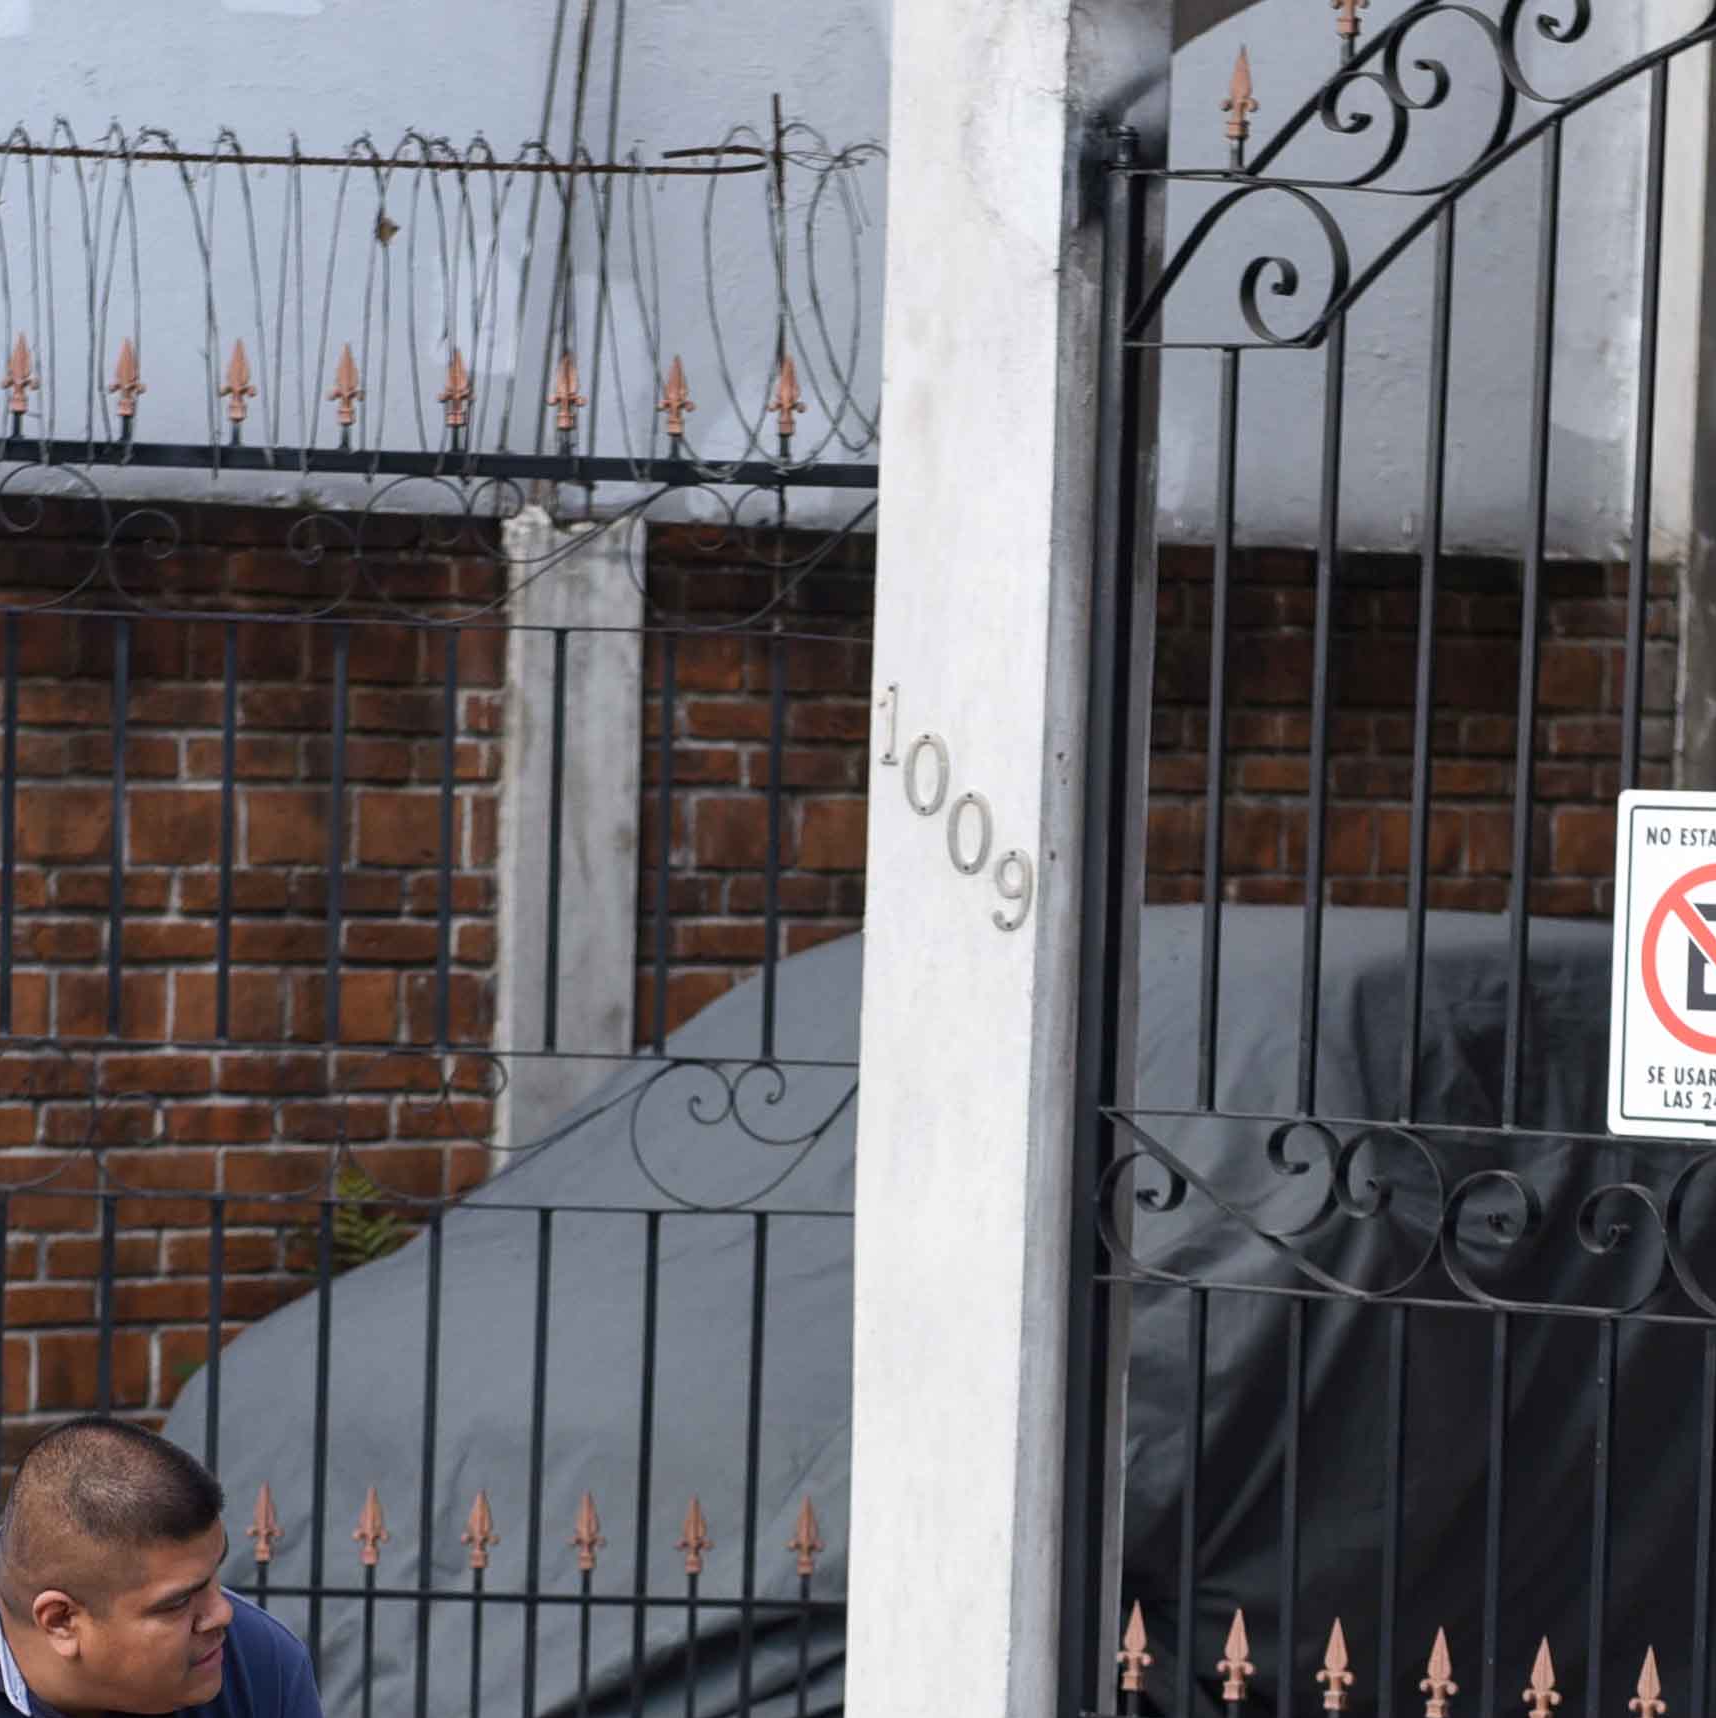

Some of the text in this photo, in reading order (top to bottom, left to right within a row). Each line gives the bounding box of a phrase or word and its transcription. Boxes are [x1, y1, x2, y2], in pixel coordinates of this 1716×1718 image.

[879, 681, 1034, 932] 1009
[1646, 827, 1671, 846] NO
[1647, 1066, 1666, 1085] SE
[1663, 1090, 1694, 1109] LAS
